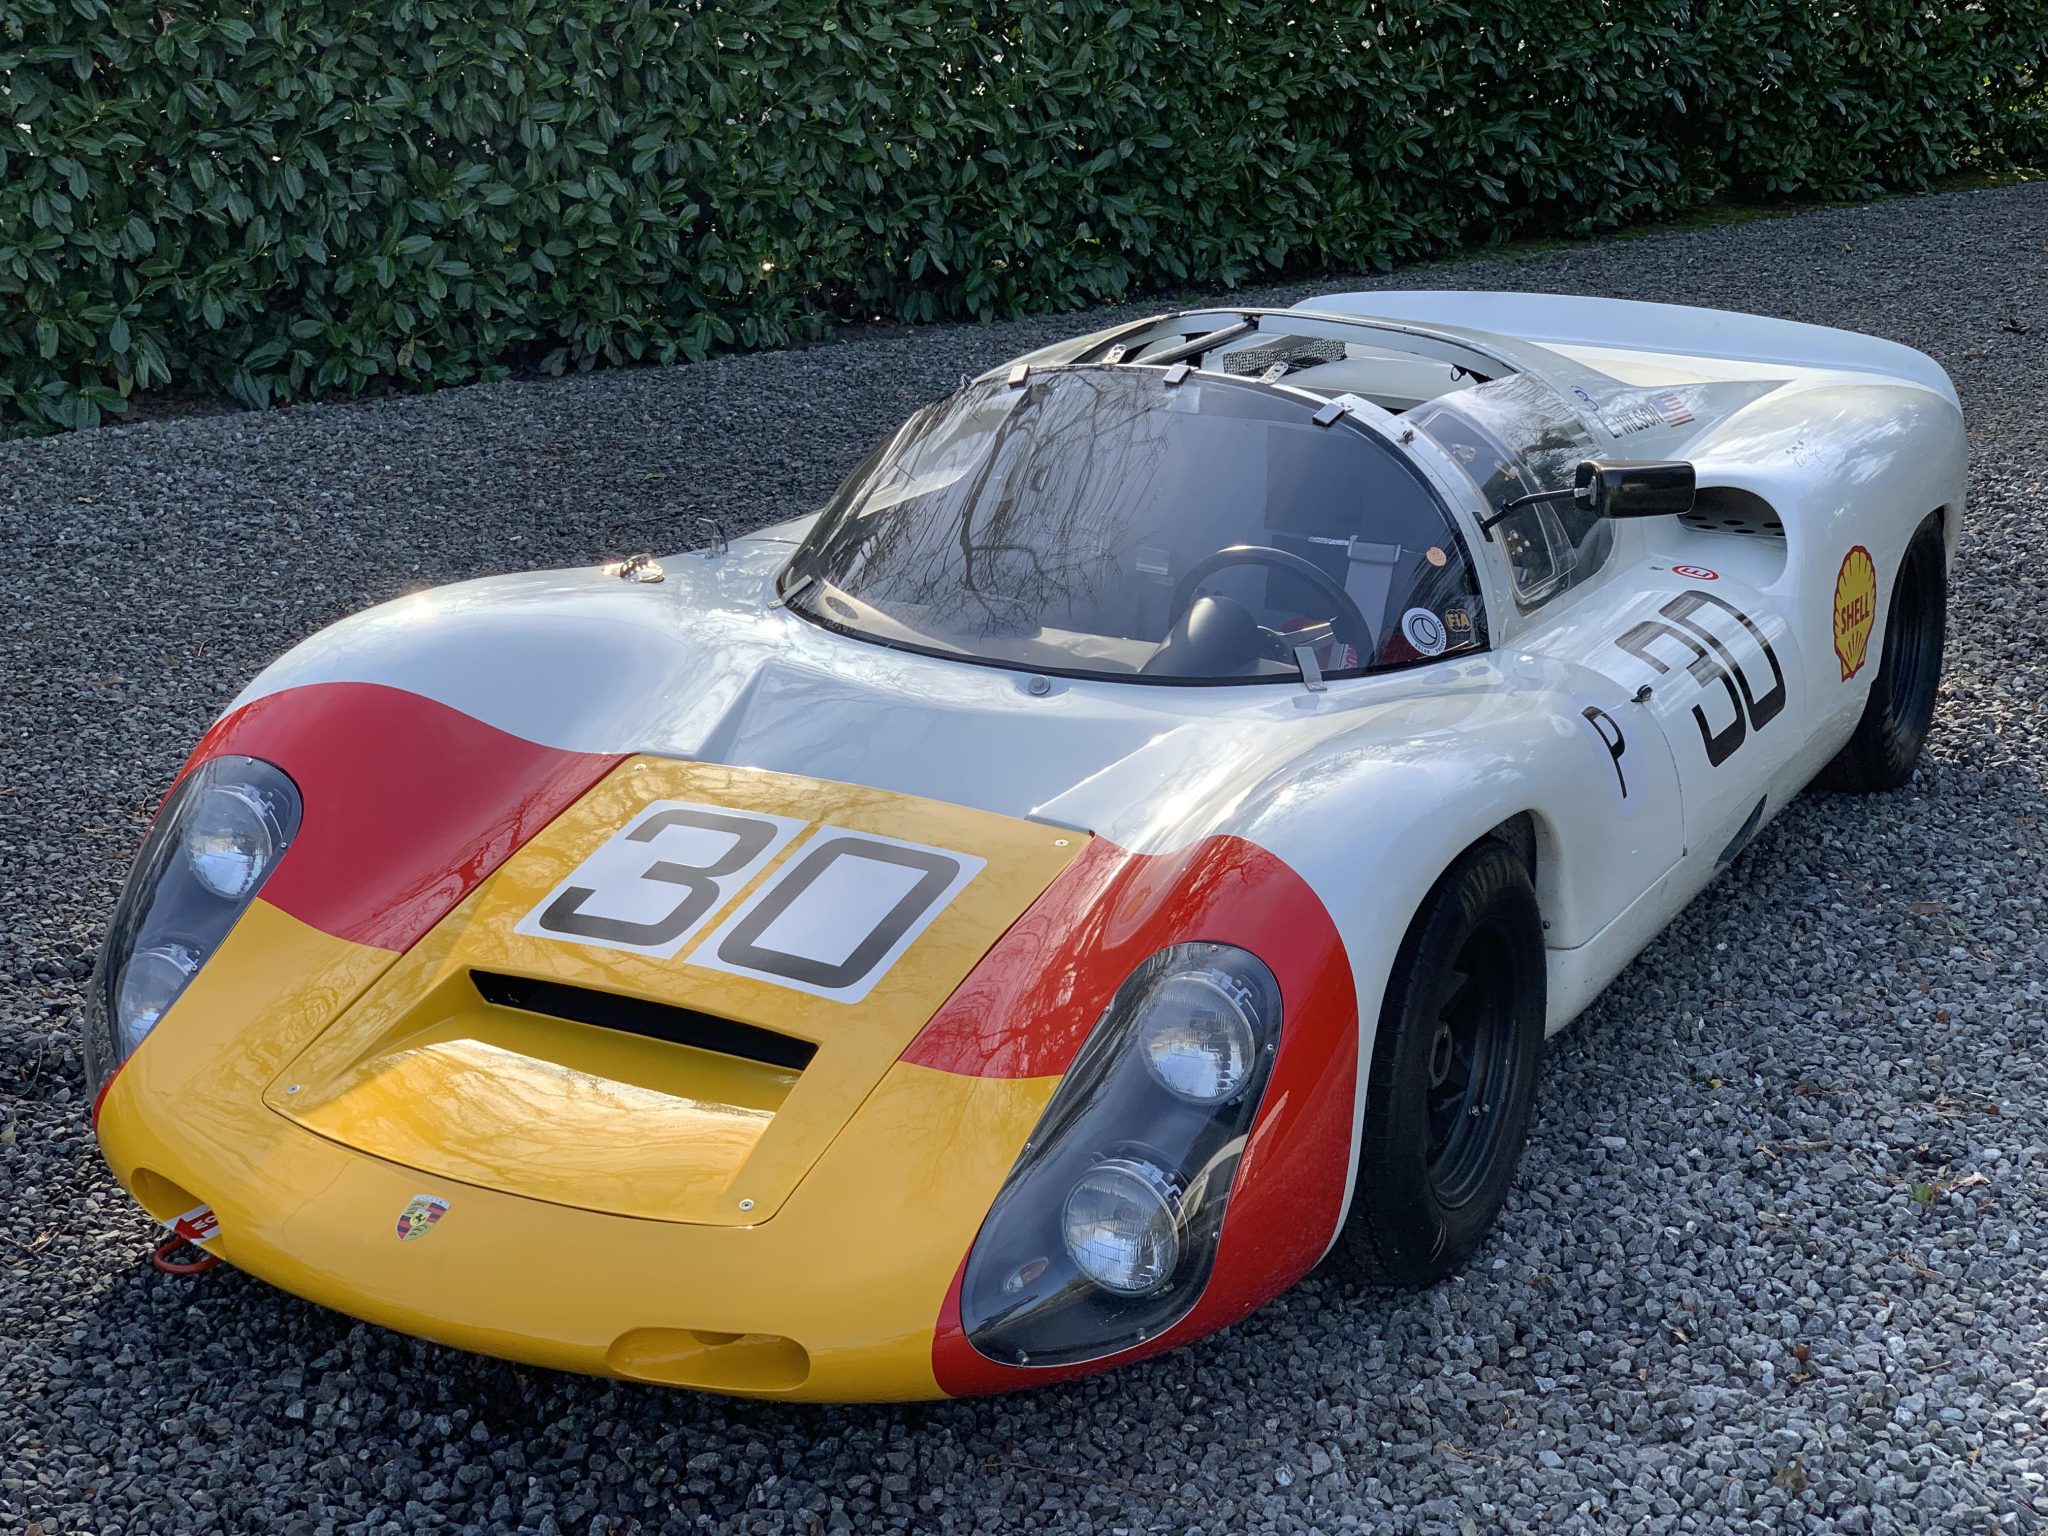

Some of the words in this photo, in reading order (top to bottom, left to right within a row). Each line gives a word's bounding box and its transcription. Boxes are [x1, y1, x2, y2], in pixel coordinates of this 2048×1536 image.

[1614, 405, 1665, 435] WILSON
[1446, 612, 1471, 628] FIA
[1840, 591, 1870, 636] SHELL
[1614, 589, 1787, 768] 30
[1580, 705, 1628, 799] P
[538, 807, 961, 989] 30
[191, 1215, 217, 1231] OW
